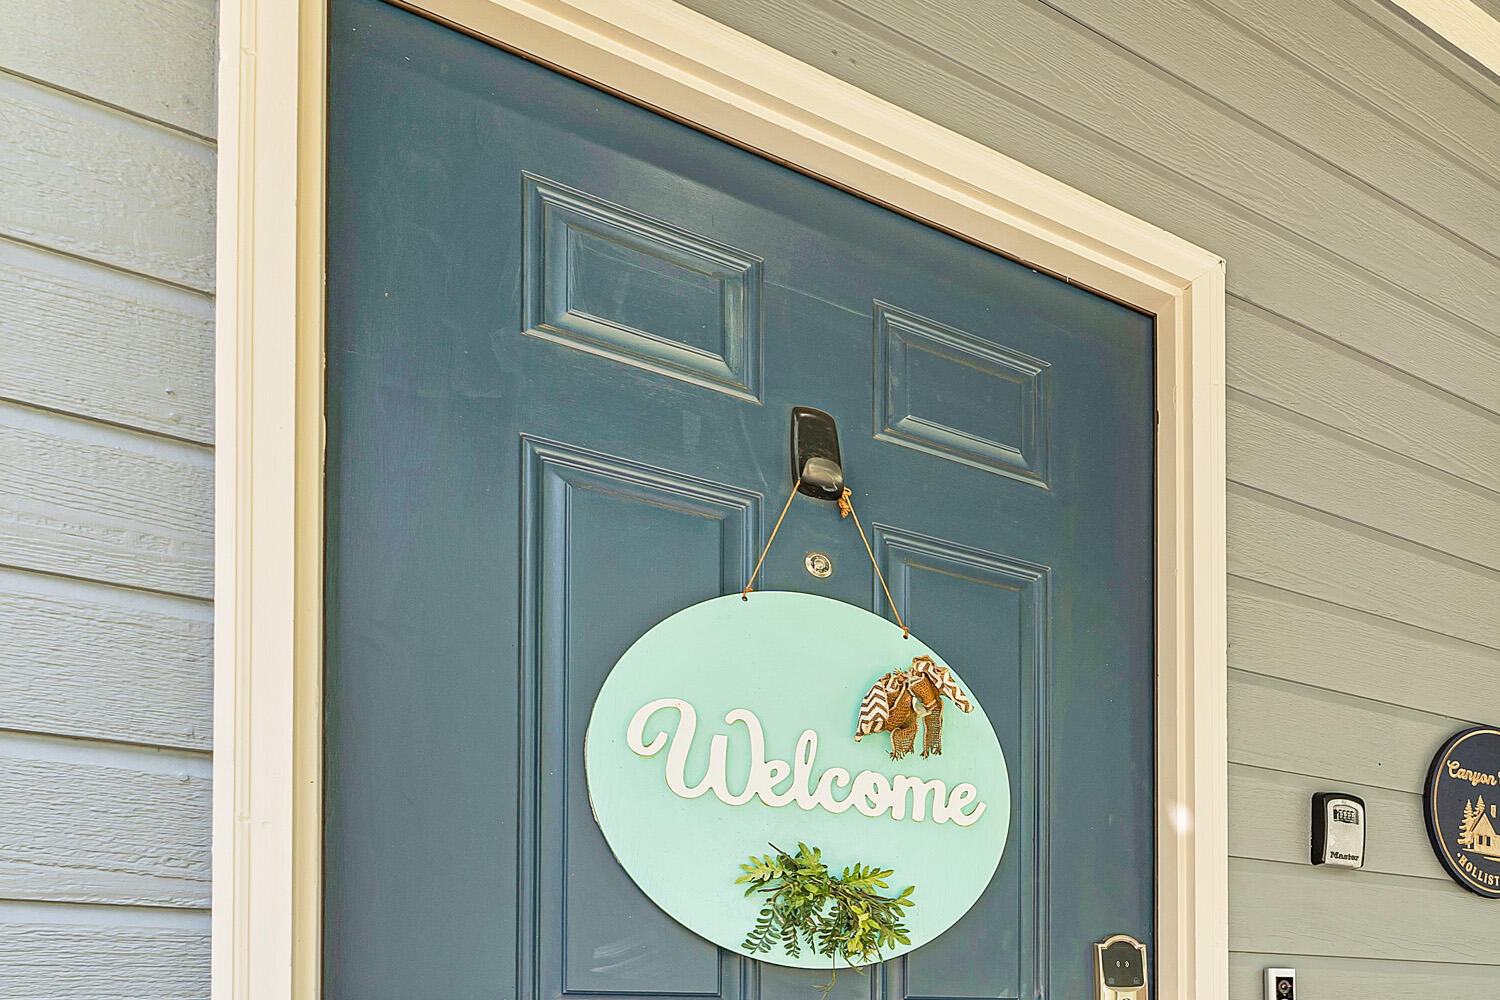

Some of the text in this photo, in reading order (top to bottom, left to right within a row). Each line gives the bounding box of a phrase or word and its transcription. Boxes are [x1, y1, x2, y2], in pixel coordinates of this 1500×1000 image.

[626, 698, 986, 827] Welcome
[1446, 760, 1497, 786] Canyon
[1330, 851, 1359, 861] Master
